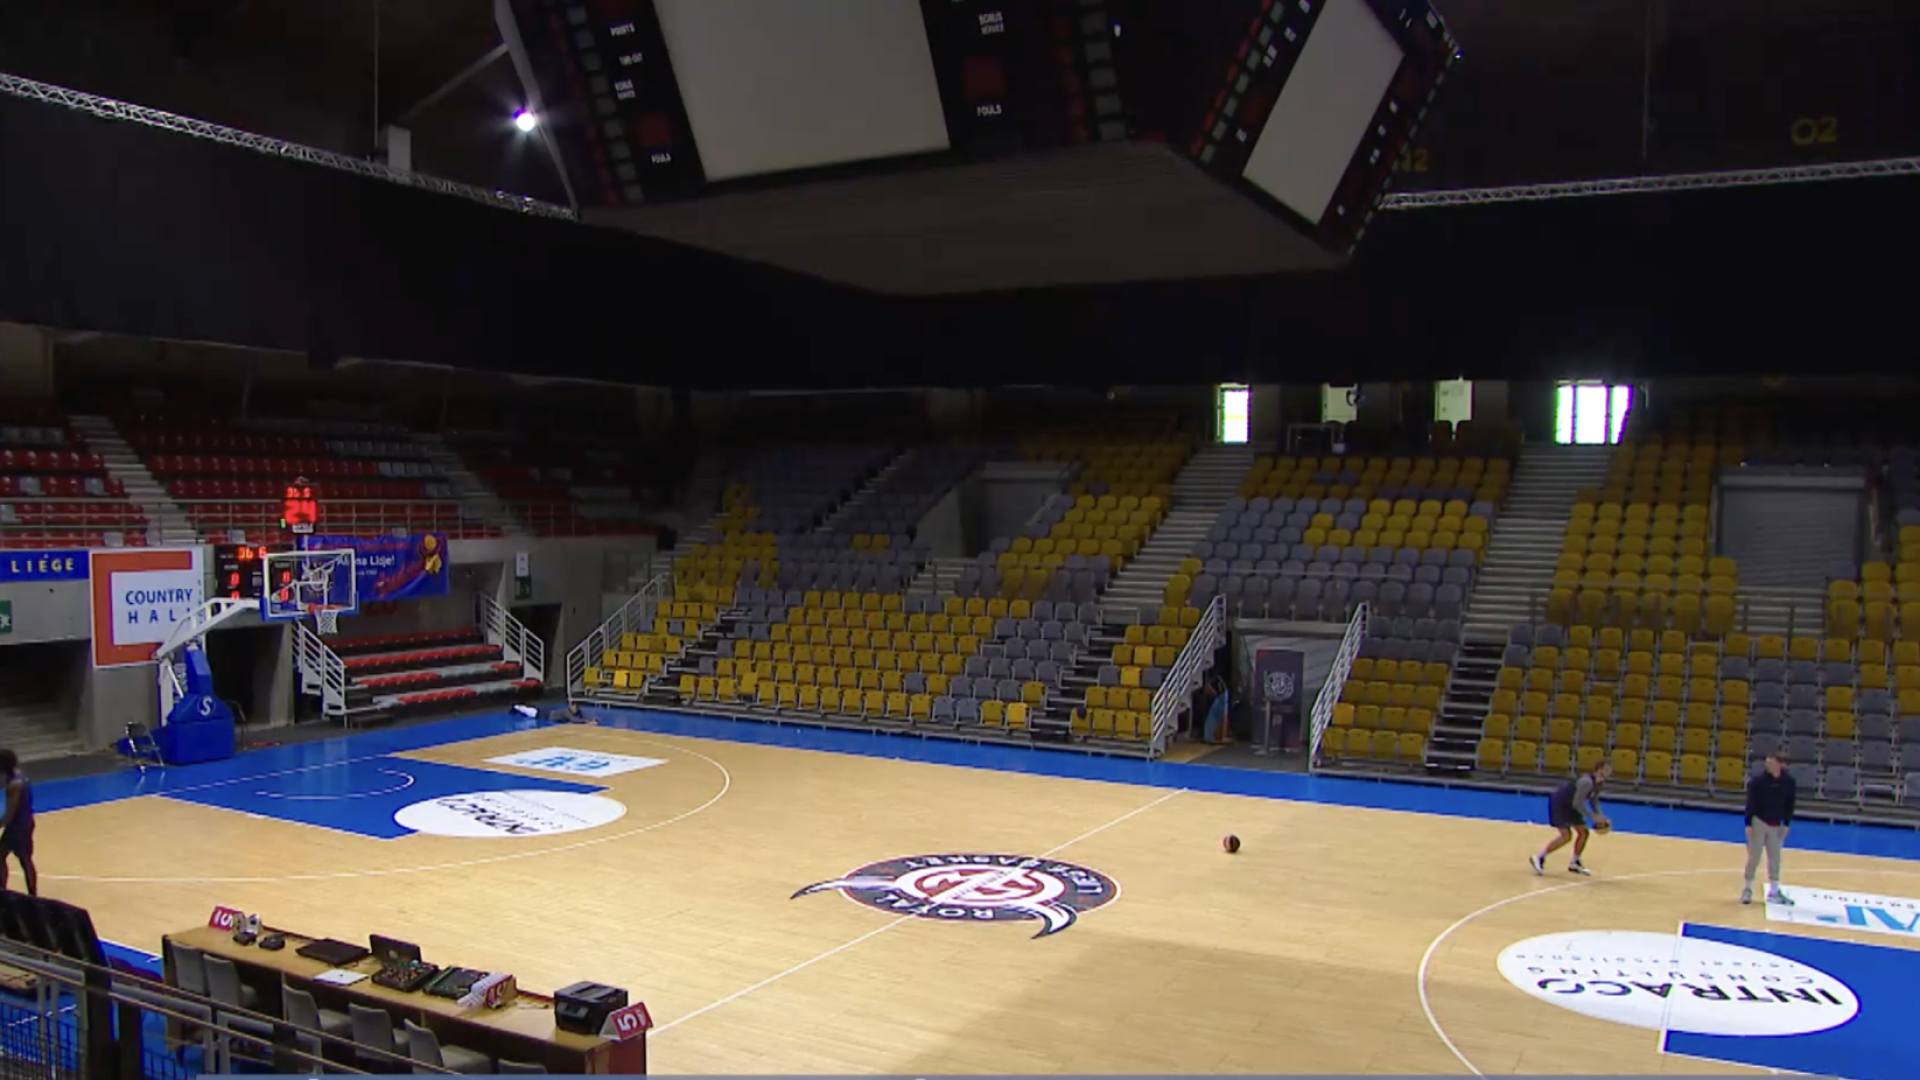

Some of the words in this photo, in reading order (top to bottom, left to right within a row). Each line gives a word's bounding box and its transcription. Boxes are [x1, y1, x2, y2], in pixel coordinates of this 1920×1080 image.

[977, 104, 1002, 117] FOULS
[285, 500, 316, 524] 24
[125, 588, 193, 605] COUNTRY
[128, 606, 191, 624] HAL
[875, 894, 996, 920] ROYAL
[1526, 966, 1814, 984] CONSULTING
[1537, 978, 1843, 1005] INTRACO
